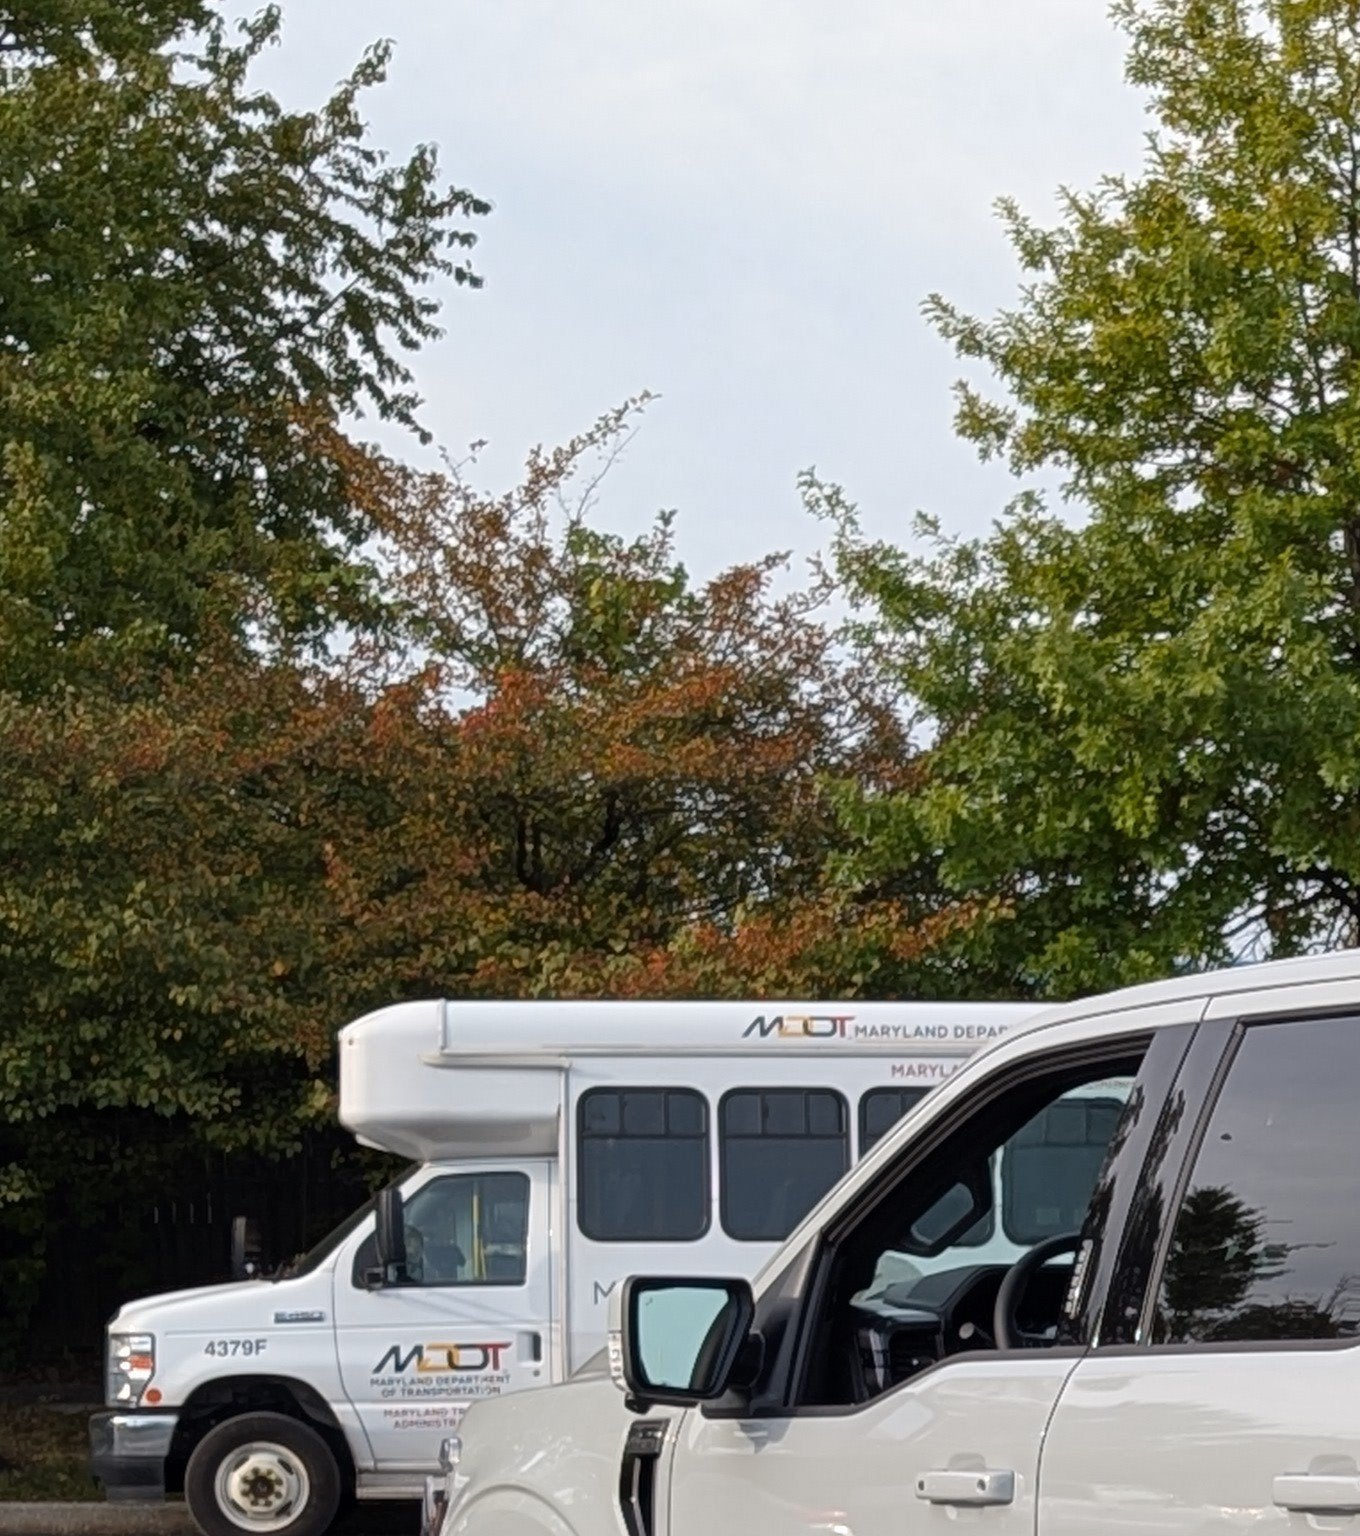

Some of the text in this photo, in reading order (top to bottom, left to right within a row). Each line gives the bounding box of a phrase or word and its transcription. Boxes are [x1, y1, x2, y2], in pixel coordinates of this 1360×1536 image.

[742, 1015, 855, 1039] MDOT
[854, 1024, 949, 1039] MARYLAND
[203, 1338, 268, 1358] 4379F
[372, 1341, 513, 1374] MDOT
[369, 1374, 511, 1387] MARYLAND DEPARTMENT
[381, 1386, 502, 1398] OF TRANSPORTATION
[383, 1408, 449, 1418] MARYLAND
